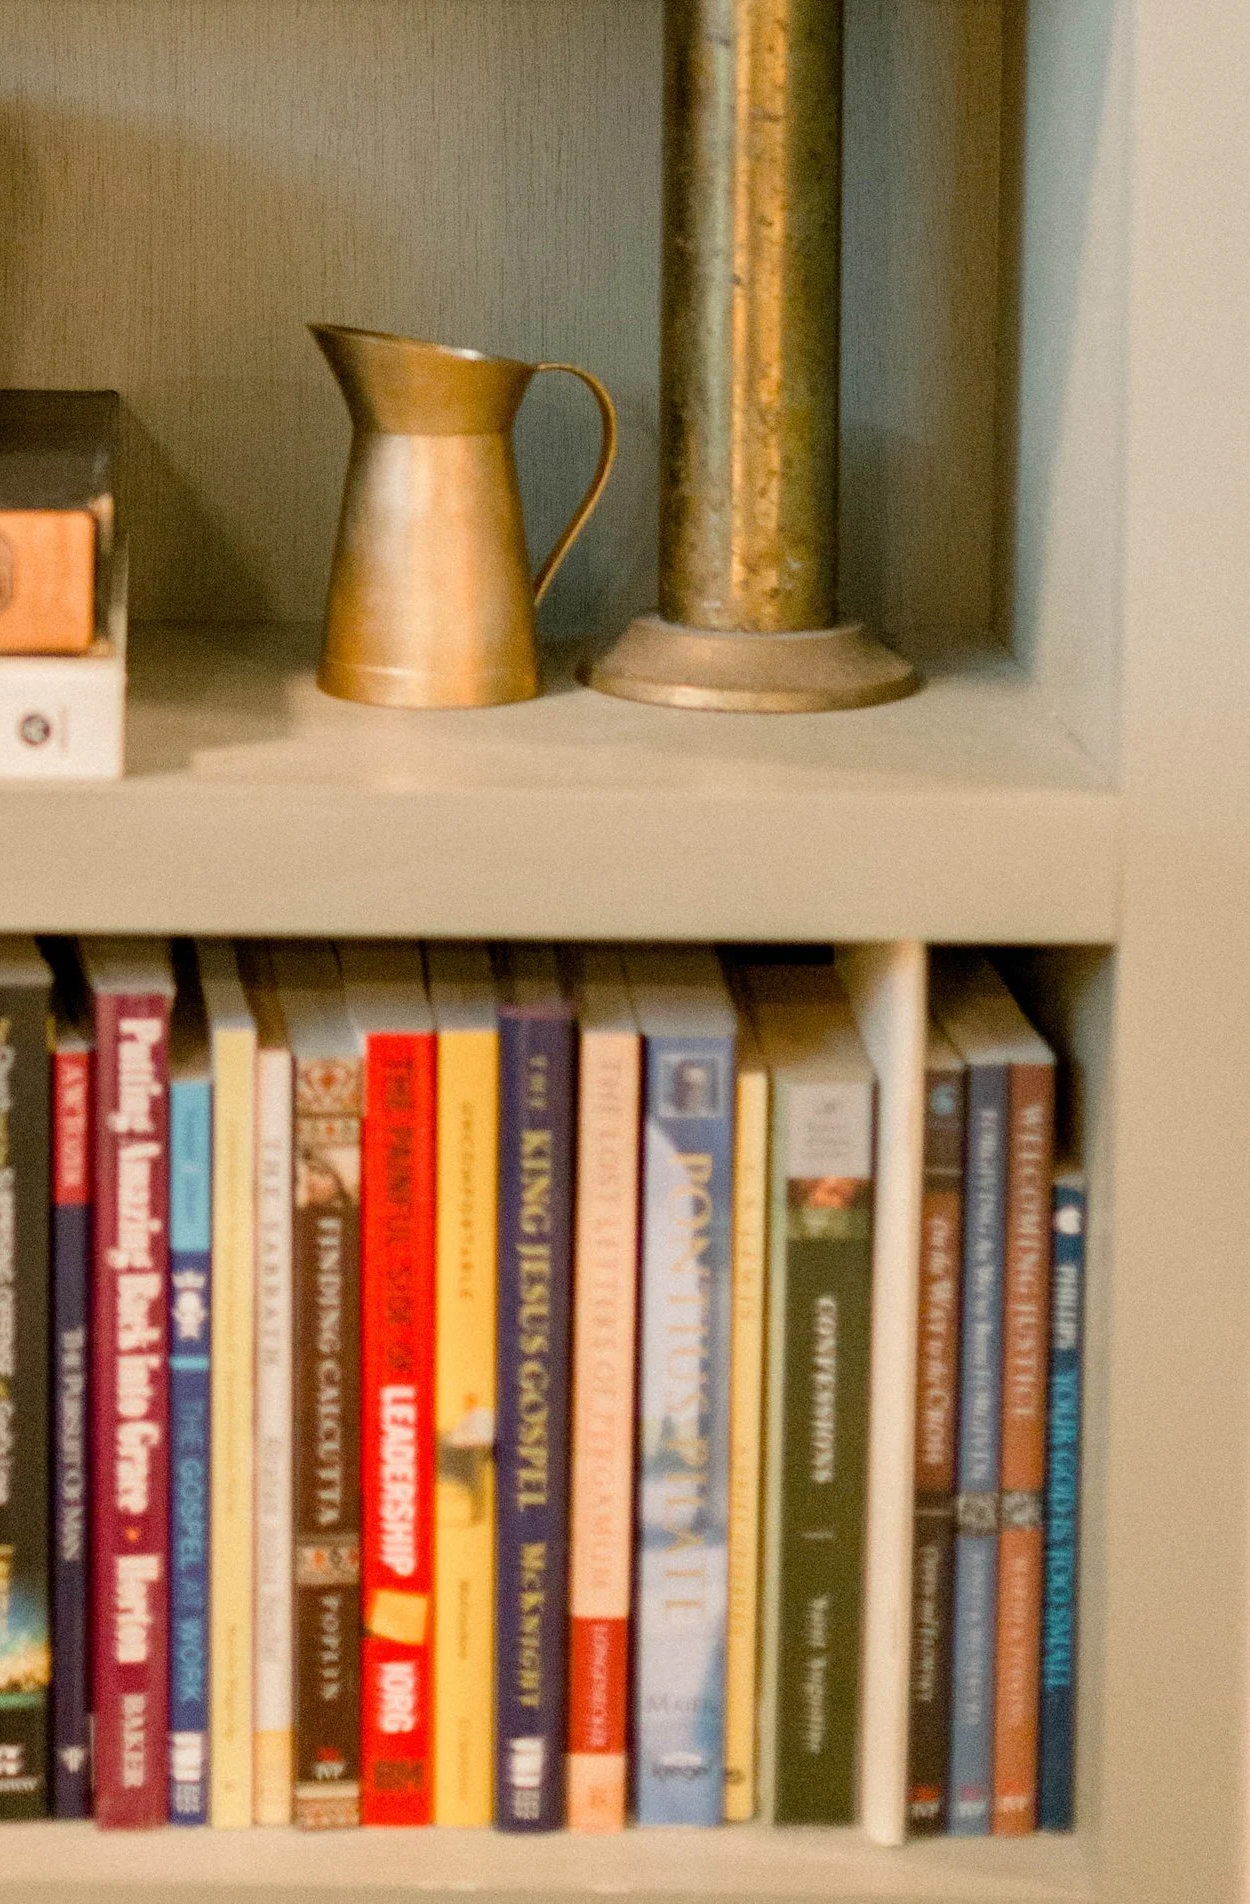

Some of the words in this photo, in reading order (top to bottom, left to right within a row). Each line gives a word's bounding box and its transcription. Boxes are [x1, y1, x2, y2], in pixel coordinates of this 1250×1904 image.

[104, 1017, 164, 1133] Putting
[387, 1060, 413, 1111] THE
[528, 1053, 549, 1111] THE
[600, 1060, 622, 1118] THE
[103, 1141, 162, 1268] Amazing
[261, 1140, 281, 1200] THE
[387, 1125, 413, 1247] PAINFUL
[518, 1128, 554, 1234] KING
[598, 1129, 621, 1204] LOST
[1016, 1103, 1043, 1296] WELCOMING
[117, 1273, 162, 1349] Back
[261, 1219, 281, 1366] SABBATH
[316, 1217, 343, 1354] FINDING
[388, 1264, 414, 1328] SIDE
[516, 1242, 551, 1355] JESUS
[594, 1217, 620, 1352] LETTERS
[667, 1152, 714, 1415] PONTIUS
[927, 1278, 954, 1335] WAY
[1056, 1264, 1077, 1350] PHILLIPS
[115, 1355, 162, 1417] into
[388, 1340, 414, 1376] OF
[808, 1293, 839, 1484] CONFESSIONS
[1011, 1302, 1039, 1417] JUSTICE
[176, 1399, 204, 1451] THE
[315, 1359, 342, 1525] CALCUTTA
[513, 1360, 550, 1511] GOSPEL
[923, 1388, 950, 1465] CROSS
[1051, 1371, 1077, 1446] YOUR
[113, 1422, 165, 1517] Grace
[177, 1457, 202, 1572] GOSPEL
[379, 1385, 417, 1577] LEADERSHIP
[1051, 1450, 1075, 1513] GOD
[61, 1505, 83, 1561] MAN
[663, 1438, 709, 1621] PILATE
[1049, 1545, 1073, 1603] TOO
[1051, 1518, 1075, 1540] IS
[113, 1552, 165, 1666] Horton
[178, 1577, 201, 1609] AT
[177, 1617, 203, 1704] WORK
[318, 1595, 341, 1702] POPLIN
[1044, 1608, 1072, 1689] SMALL
[121, 1692, 150, 1789] BAKER
